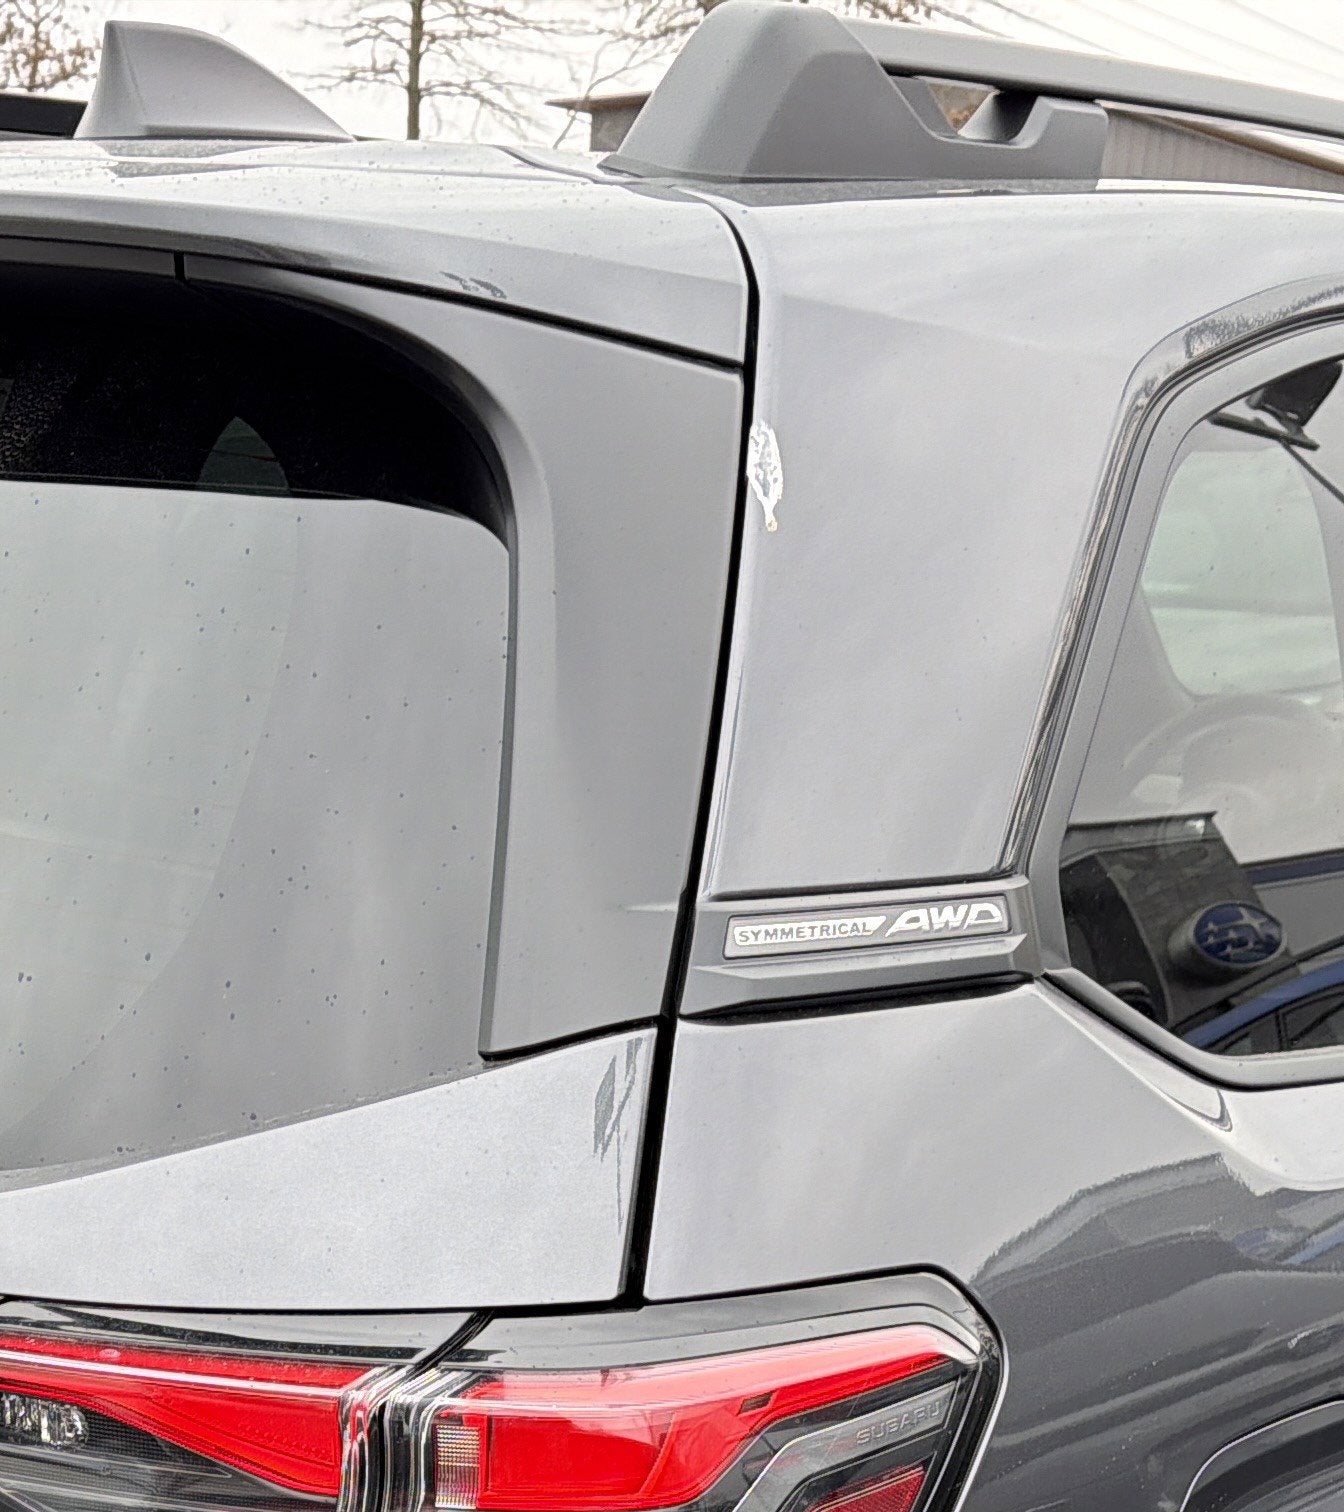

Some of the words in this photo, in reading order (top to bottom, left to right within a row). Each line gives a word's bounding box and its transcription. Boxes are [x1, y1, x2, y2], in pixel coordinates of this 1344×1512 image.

[736, 917, 875, 945] SYMMETRICAL
[884, 903, 1003, 938] AWD
[856, 1401, 940, 1444] SUBARU
